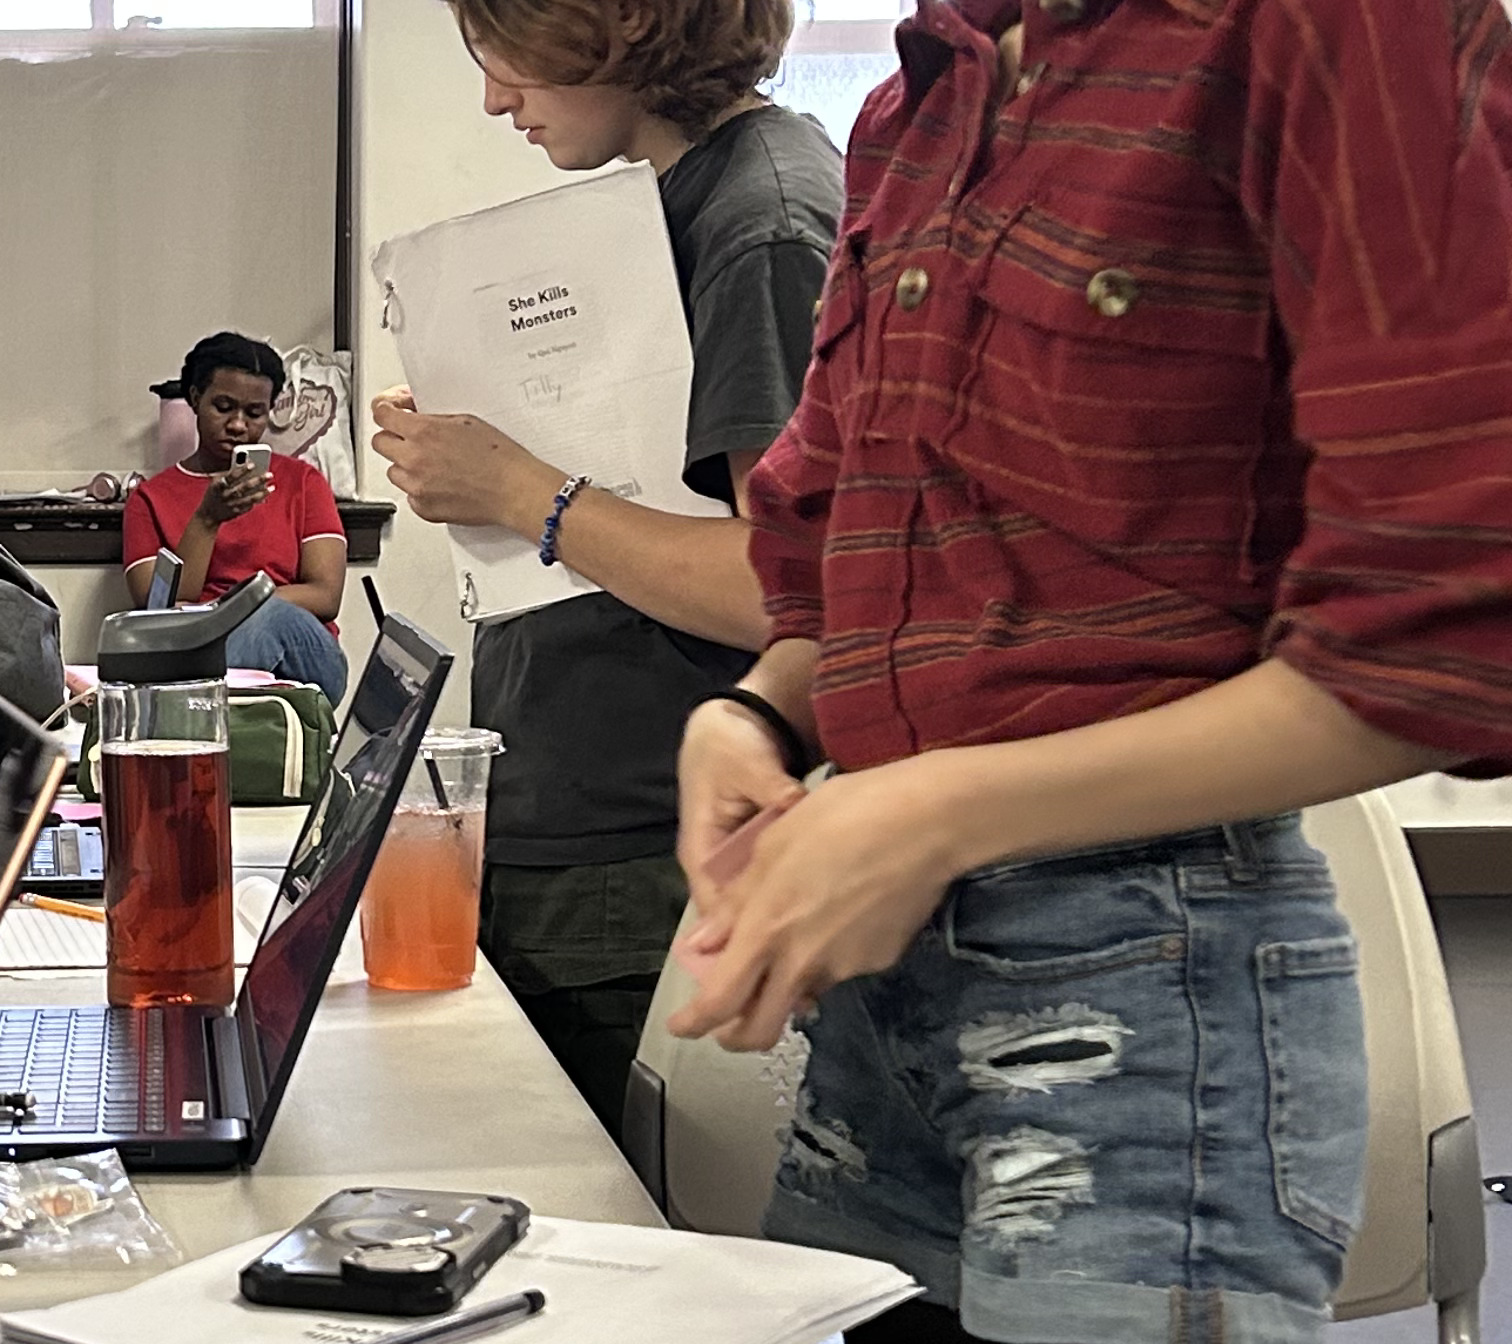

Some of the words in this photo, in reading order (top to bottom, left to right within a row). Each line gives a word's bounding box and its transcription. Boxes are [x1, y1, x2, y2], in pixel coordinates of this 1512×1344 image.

[508, 296, 536, 312] She
[538, 285, 569, 304] Kills
[510, 305, 577, 332] Monsters
[518, 374, 562, 403] Tilly
